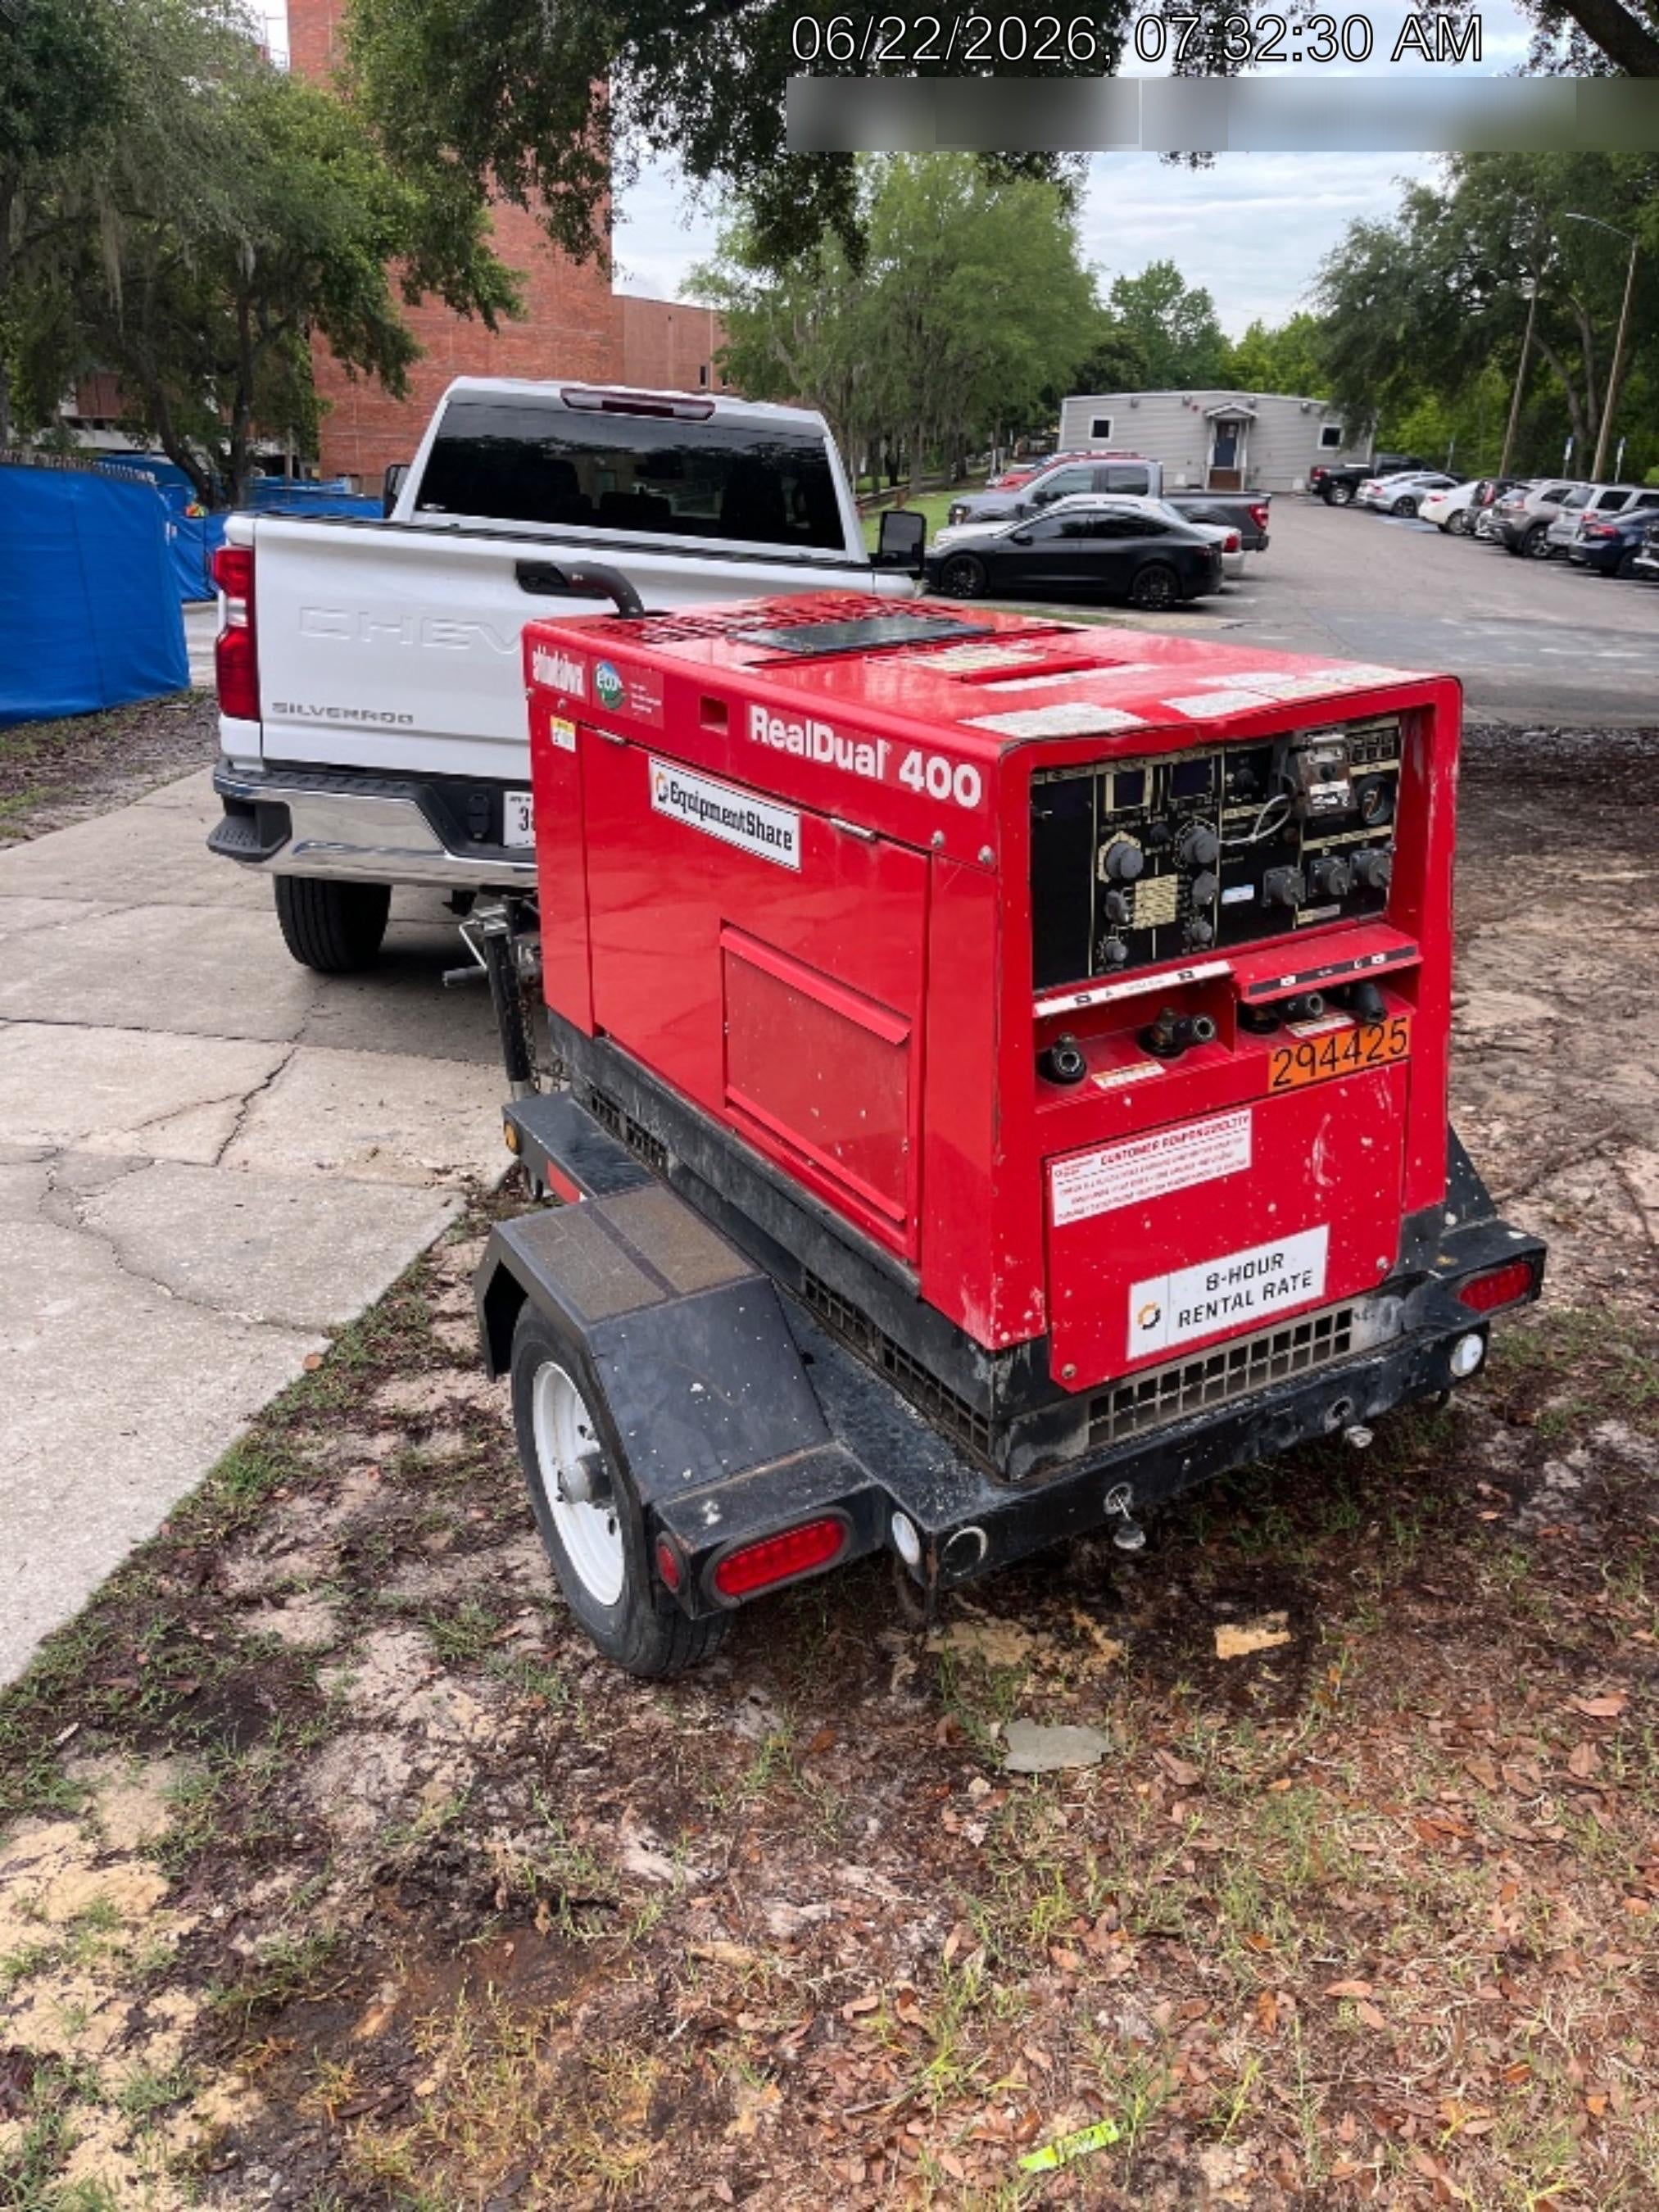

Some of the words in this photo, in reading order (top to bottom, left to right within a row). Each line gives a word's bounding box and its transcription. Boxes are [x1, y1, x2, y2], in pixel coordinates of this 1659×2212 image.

[272, 702, 414, 724] SILVERADO
[899, 749, 982, 809] 400
[670, 781, 794, 851] EquipmentShare
[1273, 1017, 1407, 1087] 294425
[1177, 1290, 1255, 1328] RENTAL
[1262, 1269, 1314, 1301] RATE
[1206, 1253, 1285, 1292] 8-HOUR
